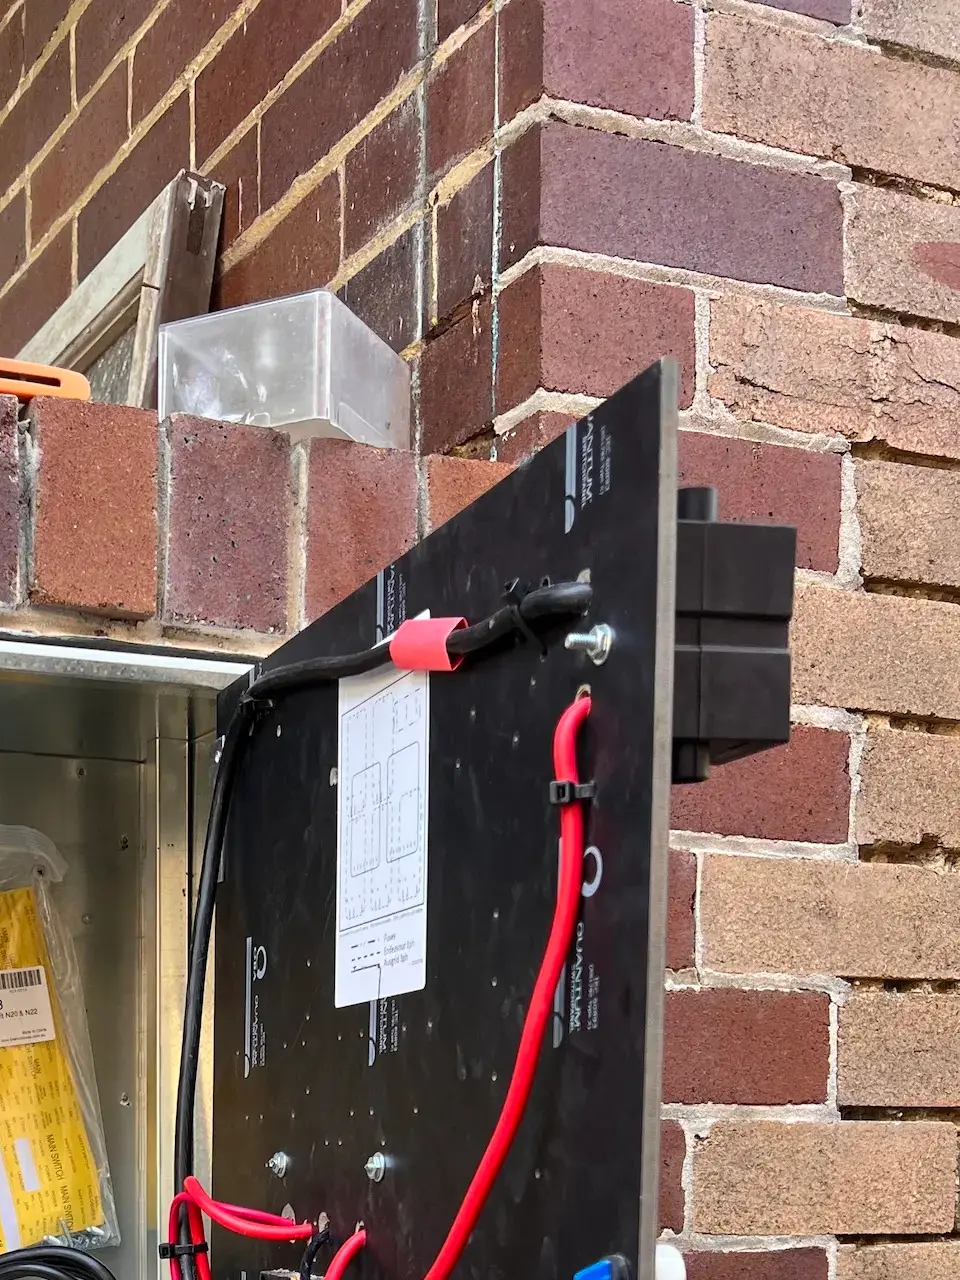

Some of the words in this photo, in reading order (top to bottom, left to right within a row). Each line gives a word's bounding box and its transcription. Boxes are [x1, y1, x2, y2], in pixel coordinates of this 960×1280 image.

[6, 1010, 18, 1018] N20
[26, 1008, 38, 1016] N22
[46, 1134, 57, 1152] MAIN
[51, 1153, 64, 1180] SWITCH
[60, 1186, 70, 1204] MAIN
